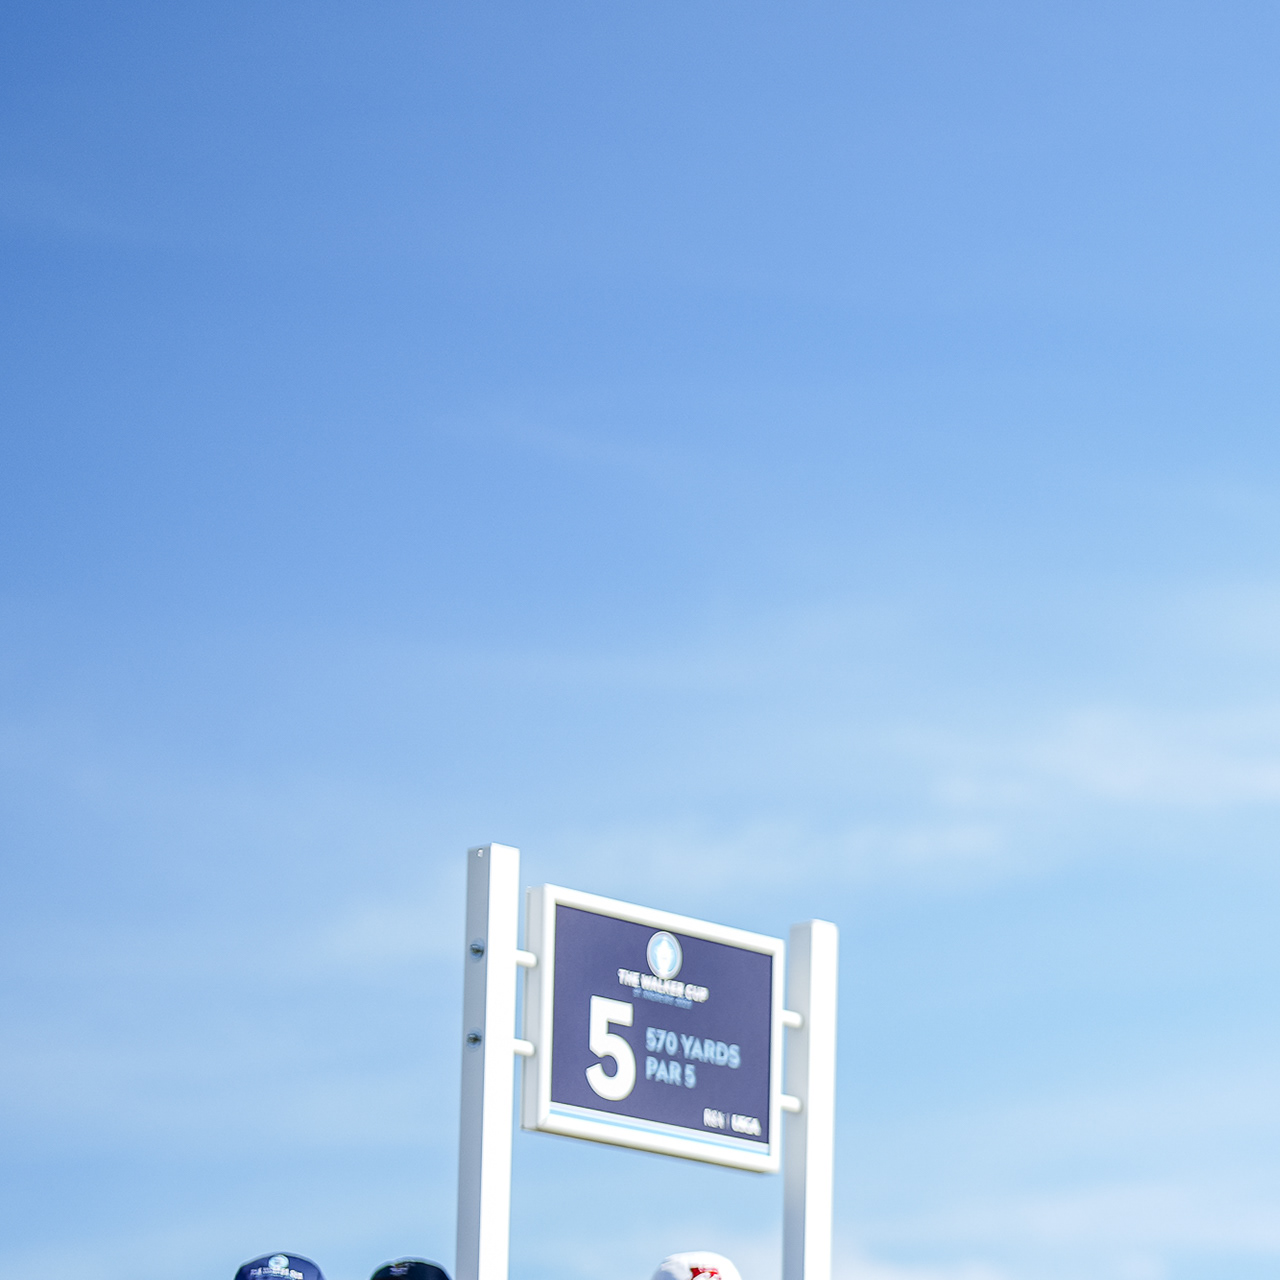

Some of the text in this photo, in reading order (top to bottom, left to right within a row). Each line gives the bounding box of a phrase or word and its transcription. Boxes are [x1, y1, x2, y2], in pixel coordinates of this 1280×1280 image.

[617, 968, 640, 988] THE
[586, 995, 636, 1101] 5
[646, 1026, 741, 1070] 570 YARDS
[646, 1056, 697, 1089] PAR 5
